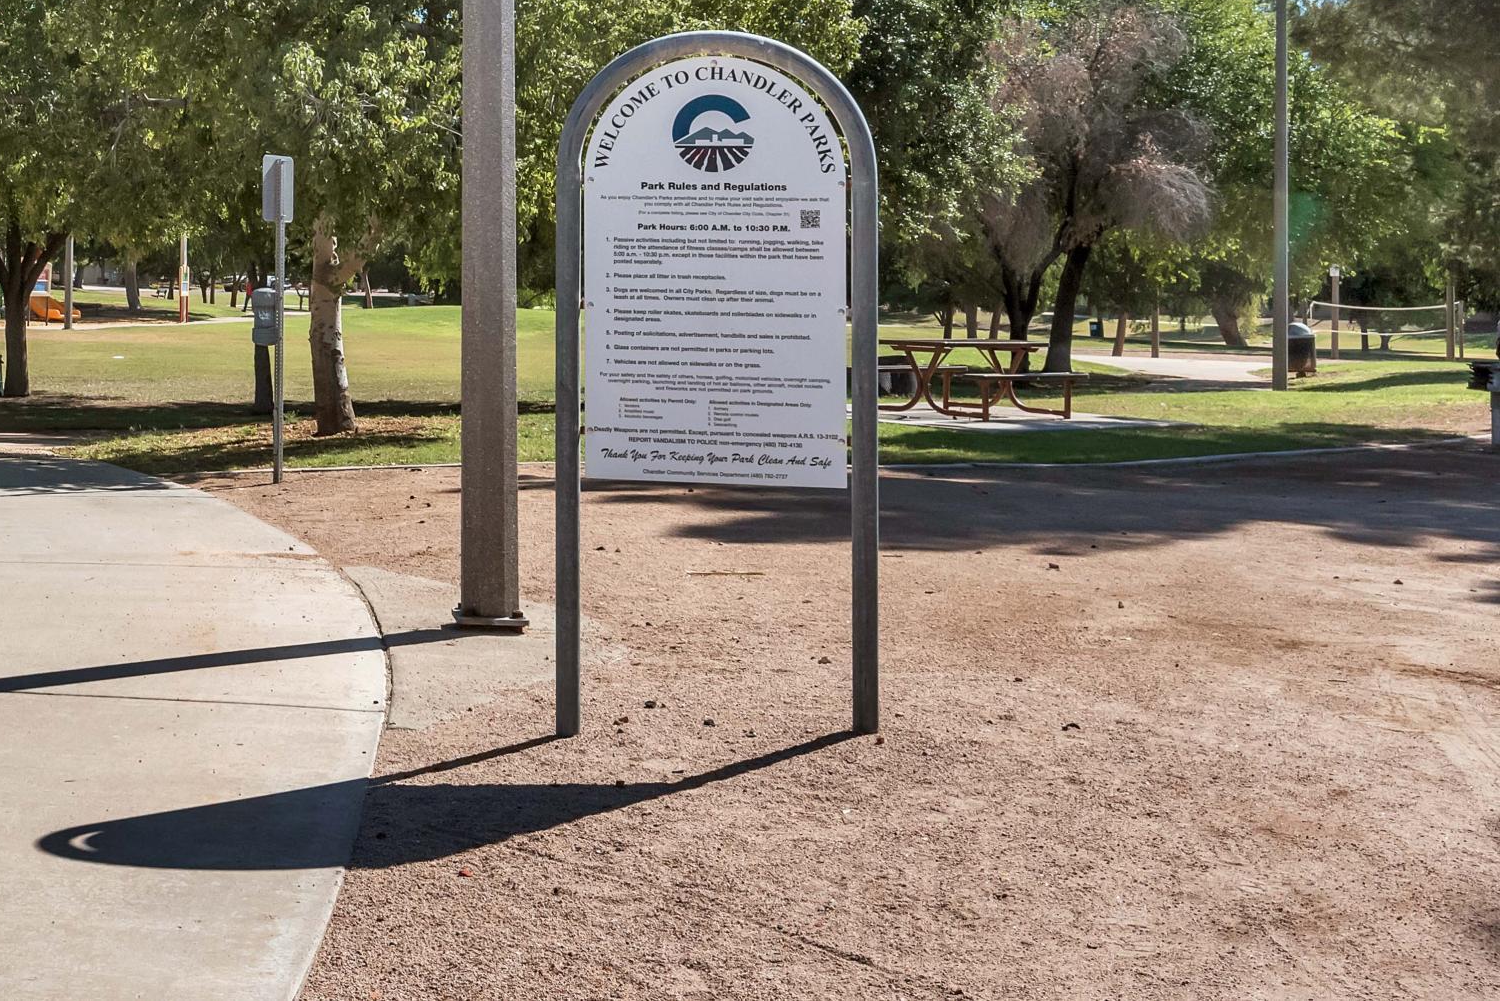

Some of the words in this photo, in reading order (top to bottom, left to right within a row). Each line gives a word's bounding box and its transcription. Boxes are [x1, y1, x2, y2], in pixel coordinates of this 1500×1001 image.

[594, 82, 664, 169] WELCOME
[660, 70, 689, 89] TO
[695, 66, 803, 115] CHANDLER
[799, 112, 836, 174] PARKS
[640, 181, 665, 189] Park
[668, 182, 697, 190] Rules
[700, 182, 720, 190] and
[724, 182, 787, 192] Regulations
[601, 448, 628, 460] Thank
[630, 449, 648, 462] You
[651, 449, 666, 463] For
[670, 450, 704, 465] Keeping
[708, 451, 728, 465] Your
[732, 452, 754, 464] Park
[757, 453, 783, 466] Clean
[785, 454, 806, 466] And
[809, 455, 832, 469] Safe
